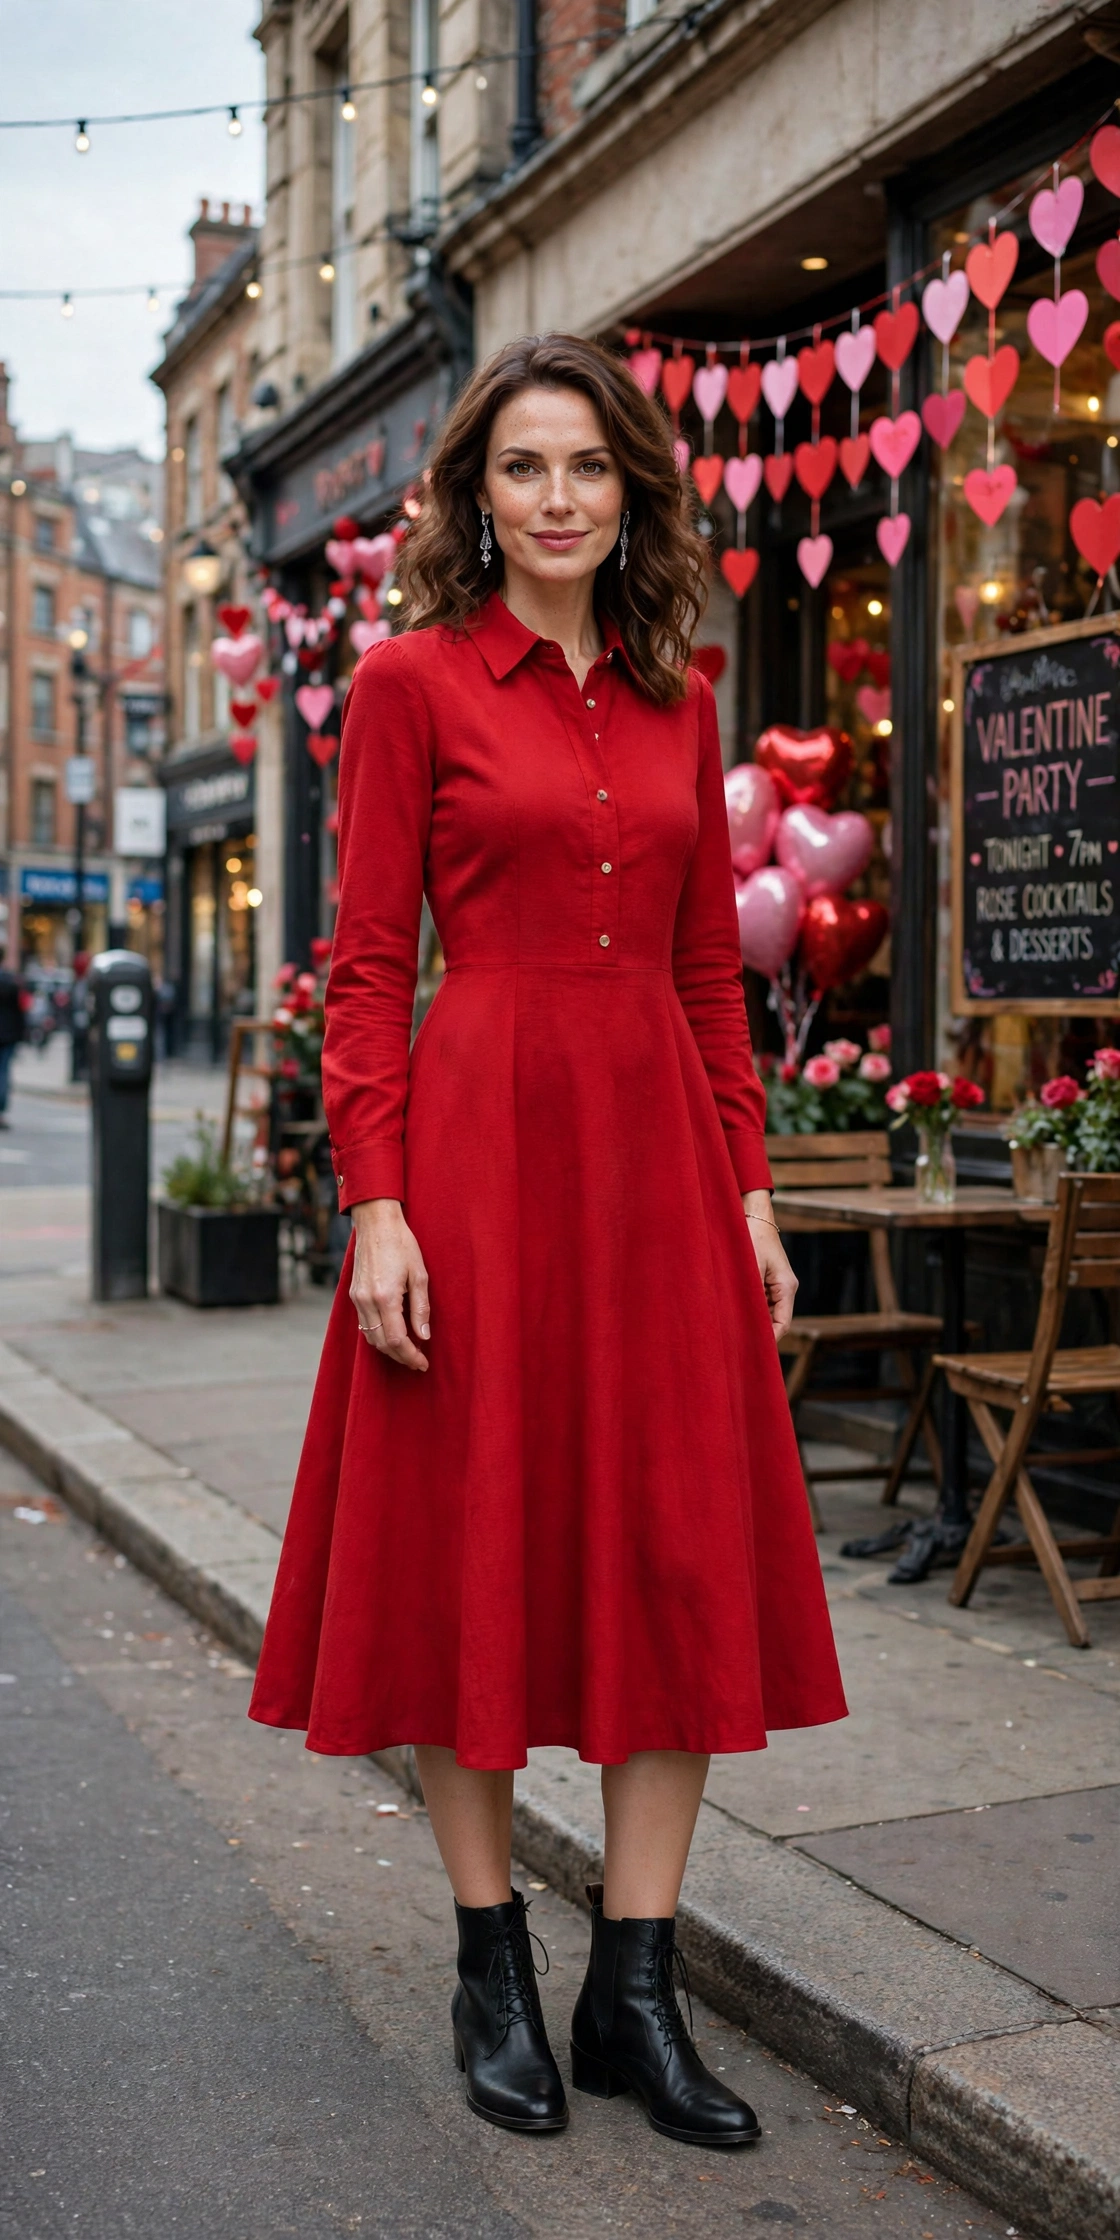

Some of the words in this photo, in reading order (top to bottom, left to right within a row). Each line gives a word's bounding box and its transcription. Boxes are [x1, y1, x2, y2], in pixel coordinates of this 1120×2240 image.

[976, 691, 1112, 764] VALENTINE
[1002, 758, 1084, 820] PARTY
[983, 833, 1053, 874] TONIGHT
[976, 885, 1018, 923] ROSE
[1021, 879, 1114, 920] COCKTAILS
[990, 928, 1005, 963] &
[1008, 926, 1094, 963] DESSERTS
